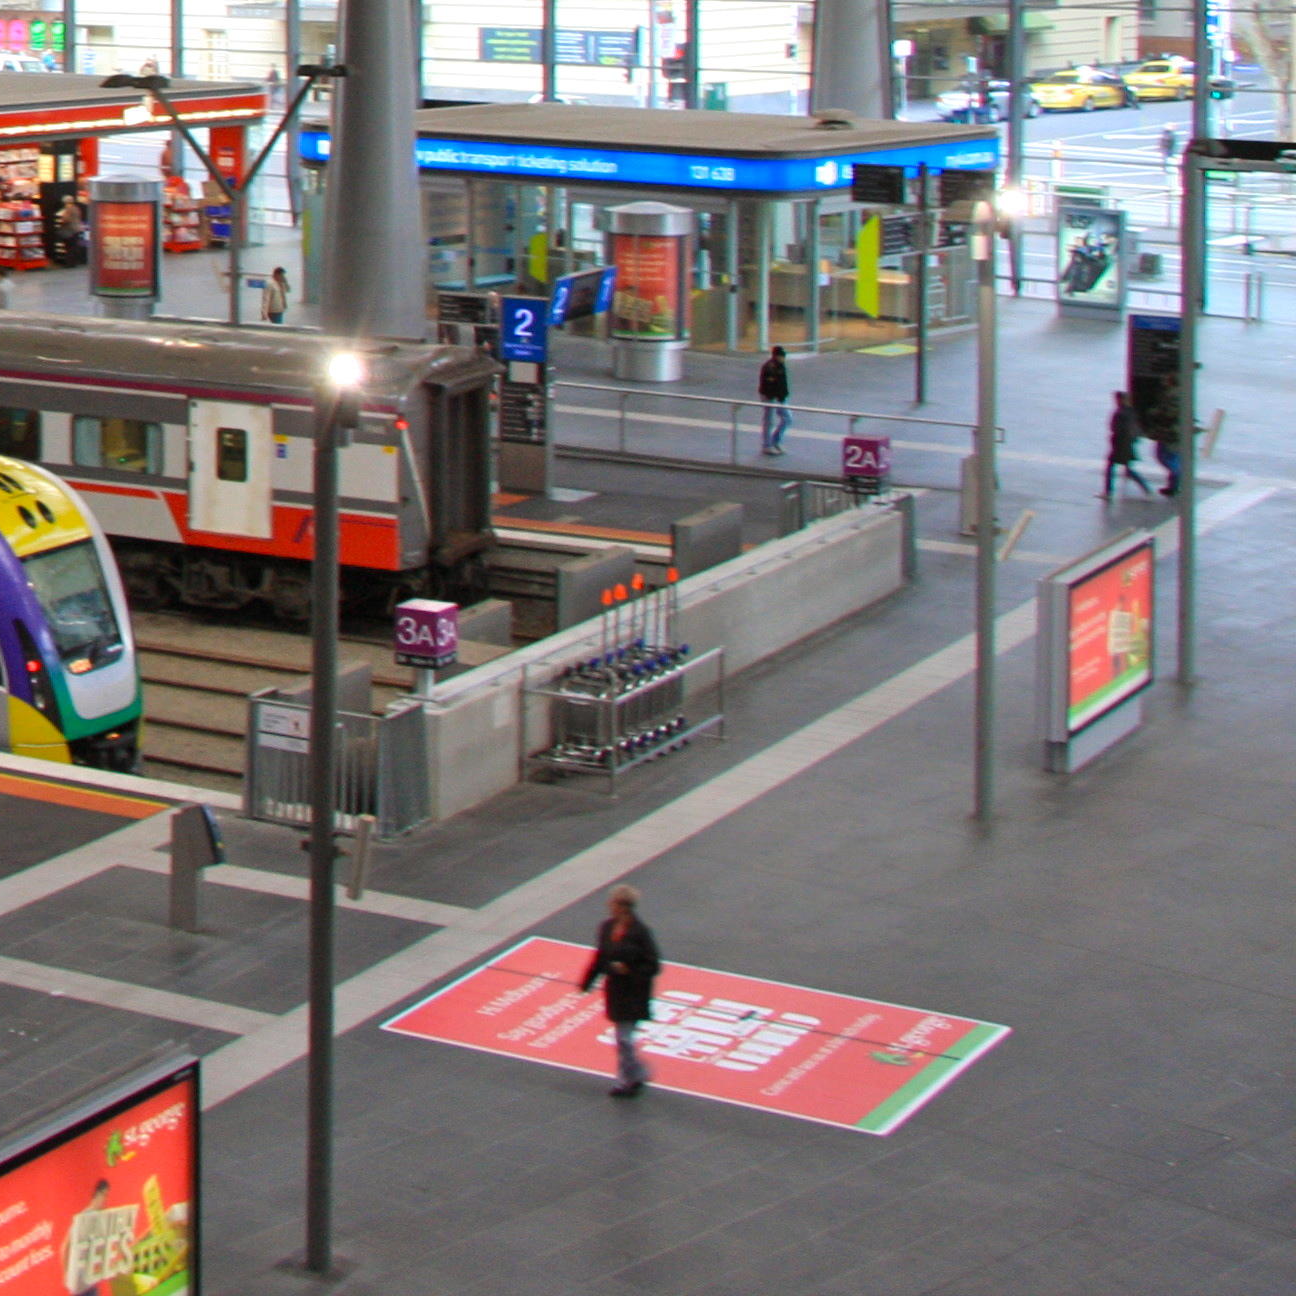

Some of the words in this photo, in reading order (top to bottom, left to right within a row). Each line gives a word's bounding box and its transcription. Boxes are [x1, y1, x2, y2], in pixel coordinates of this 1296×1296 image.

[513, 308, 534, 337] 2
[846, 445, 878, 469] 2A
[397, 616, 434, 647] 3A
